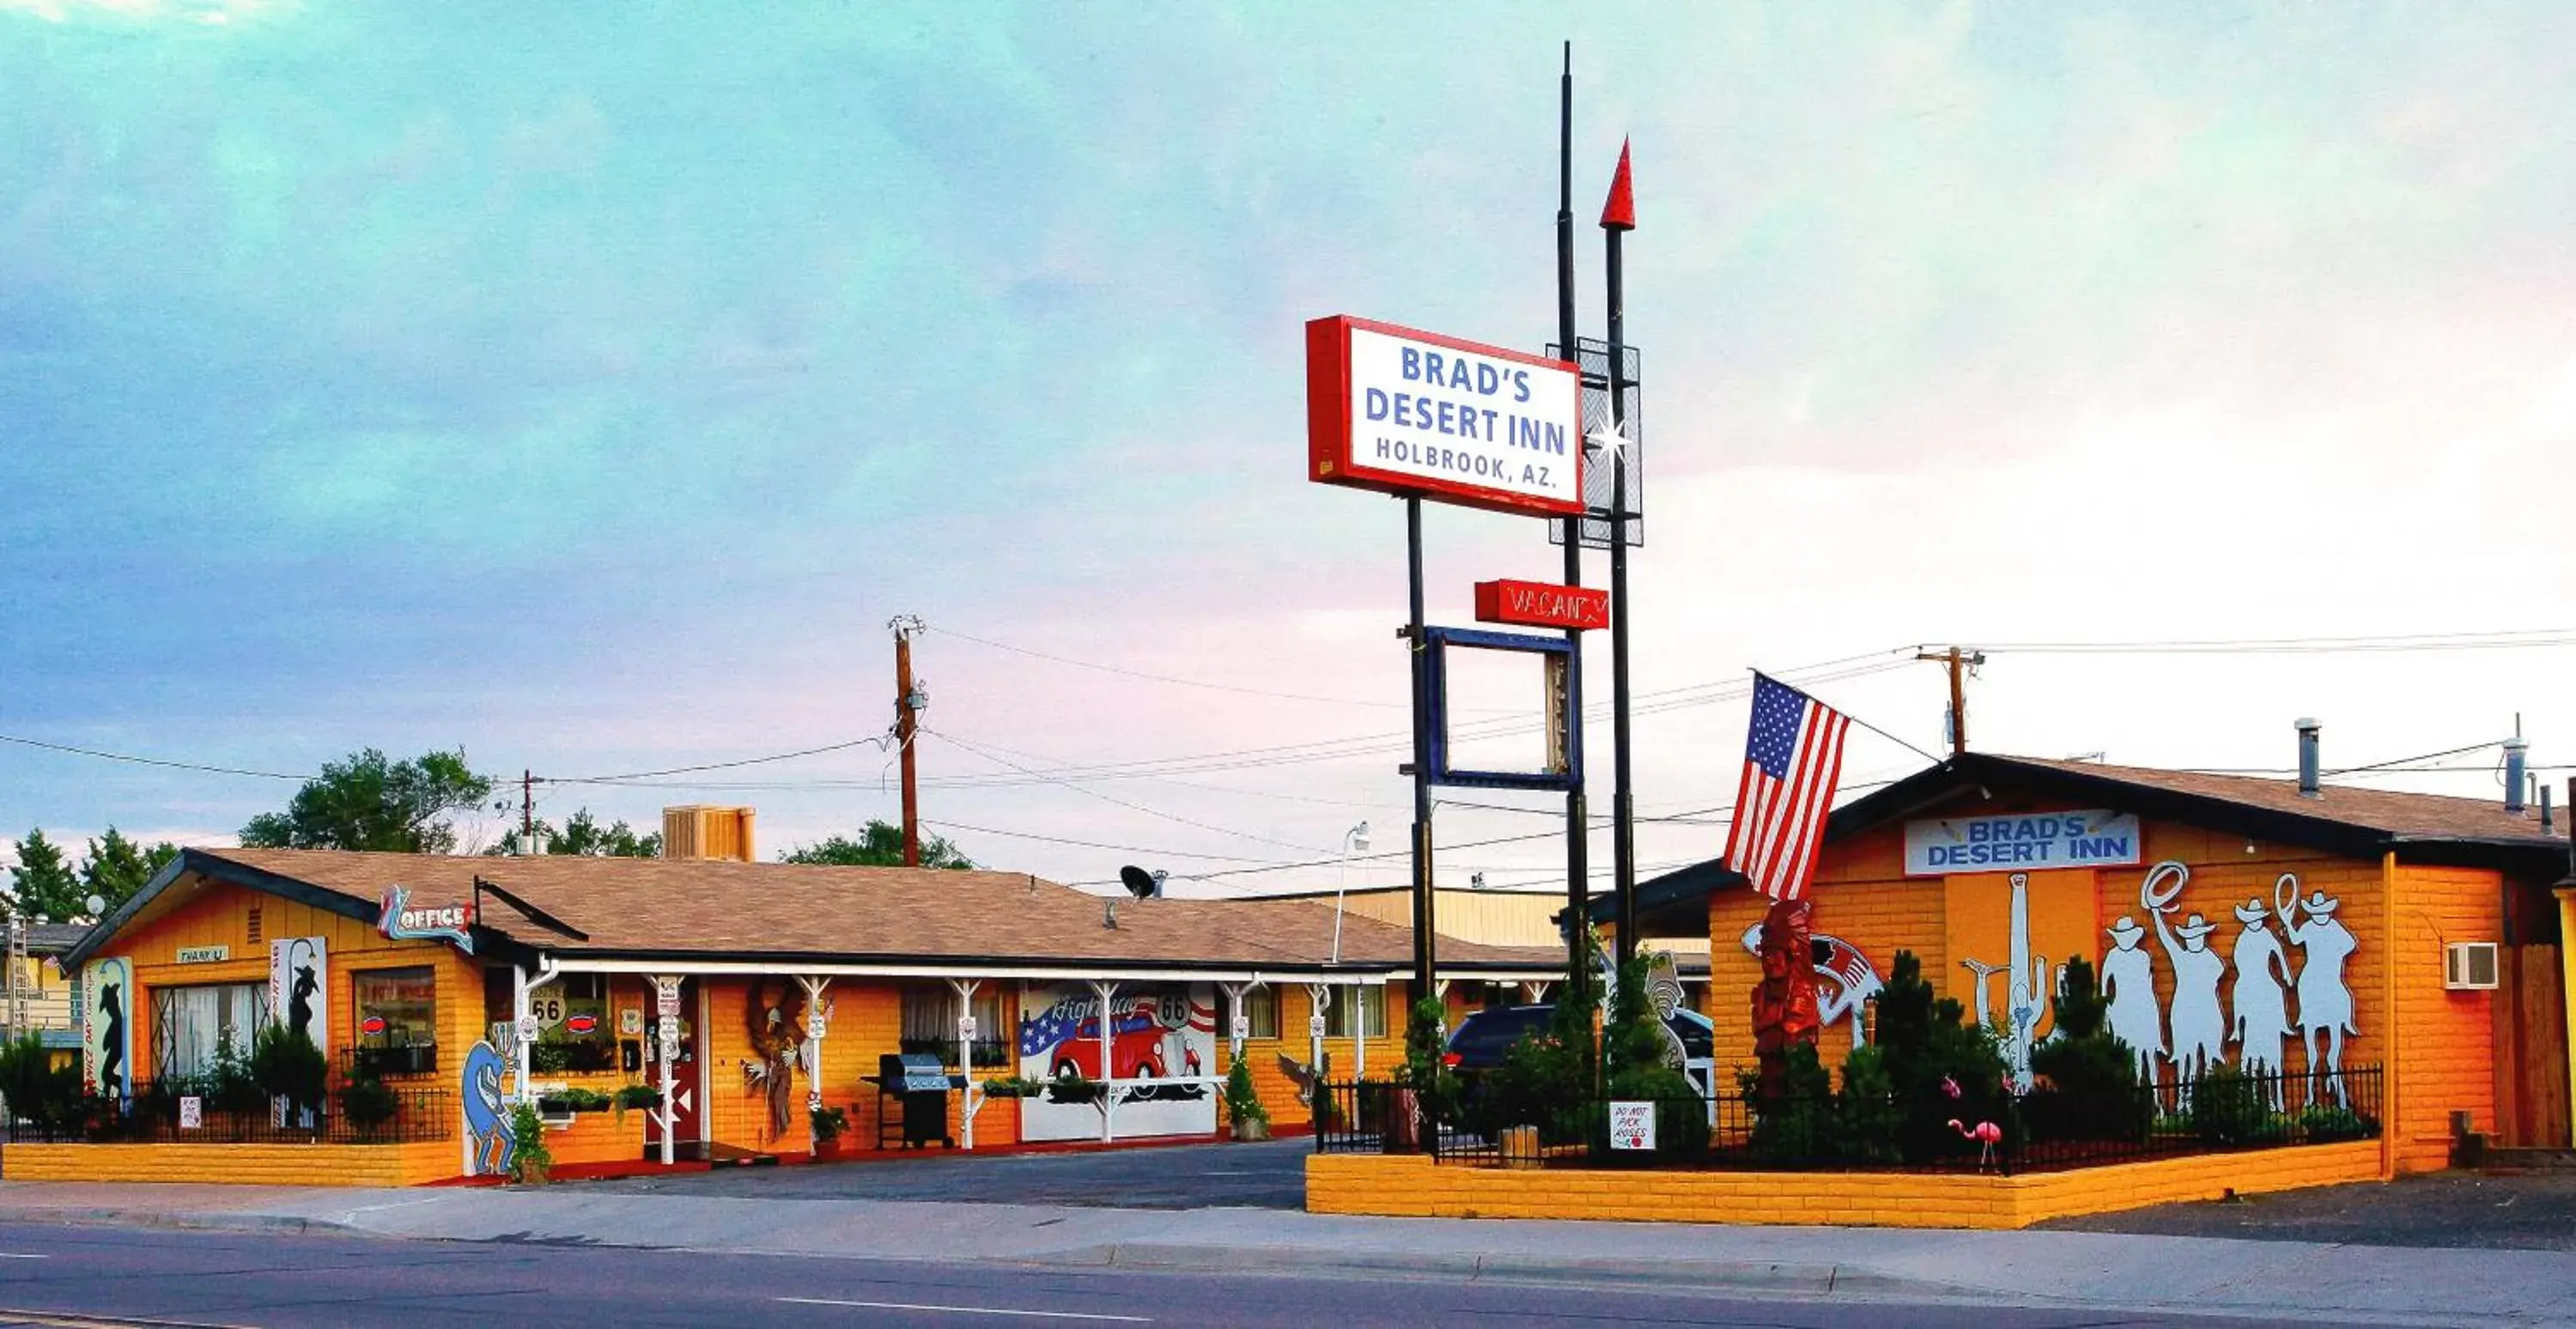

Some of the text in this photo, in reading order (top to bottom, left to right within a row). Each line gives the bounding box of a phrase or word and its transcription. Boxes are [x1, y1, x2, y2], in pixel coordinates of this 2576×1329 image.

[1401, 347, 1530, 403] BRAD'S
[1366, 386, 1565, 456] DESERT INN
[1376, 437, 1512, 483] HOLBROOK,
[1522, 463, 1558, 489] AZ.
[1969, 816, 2086, 842] BRAD'S
[1928, 837, 2128, 865] DESERT INN
[400, 907, 465, 928] OFFICE
[532, 999, 560, 1021] 66
[1162, 996, 1185, 1023] 66
[85, 1018, 94, 1045] DAY
